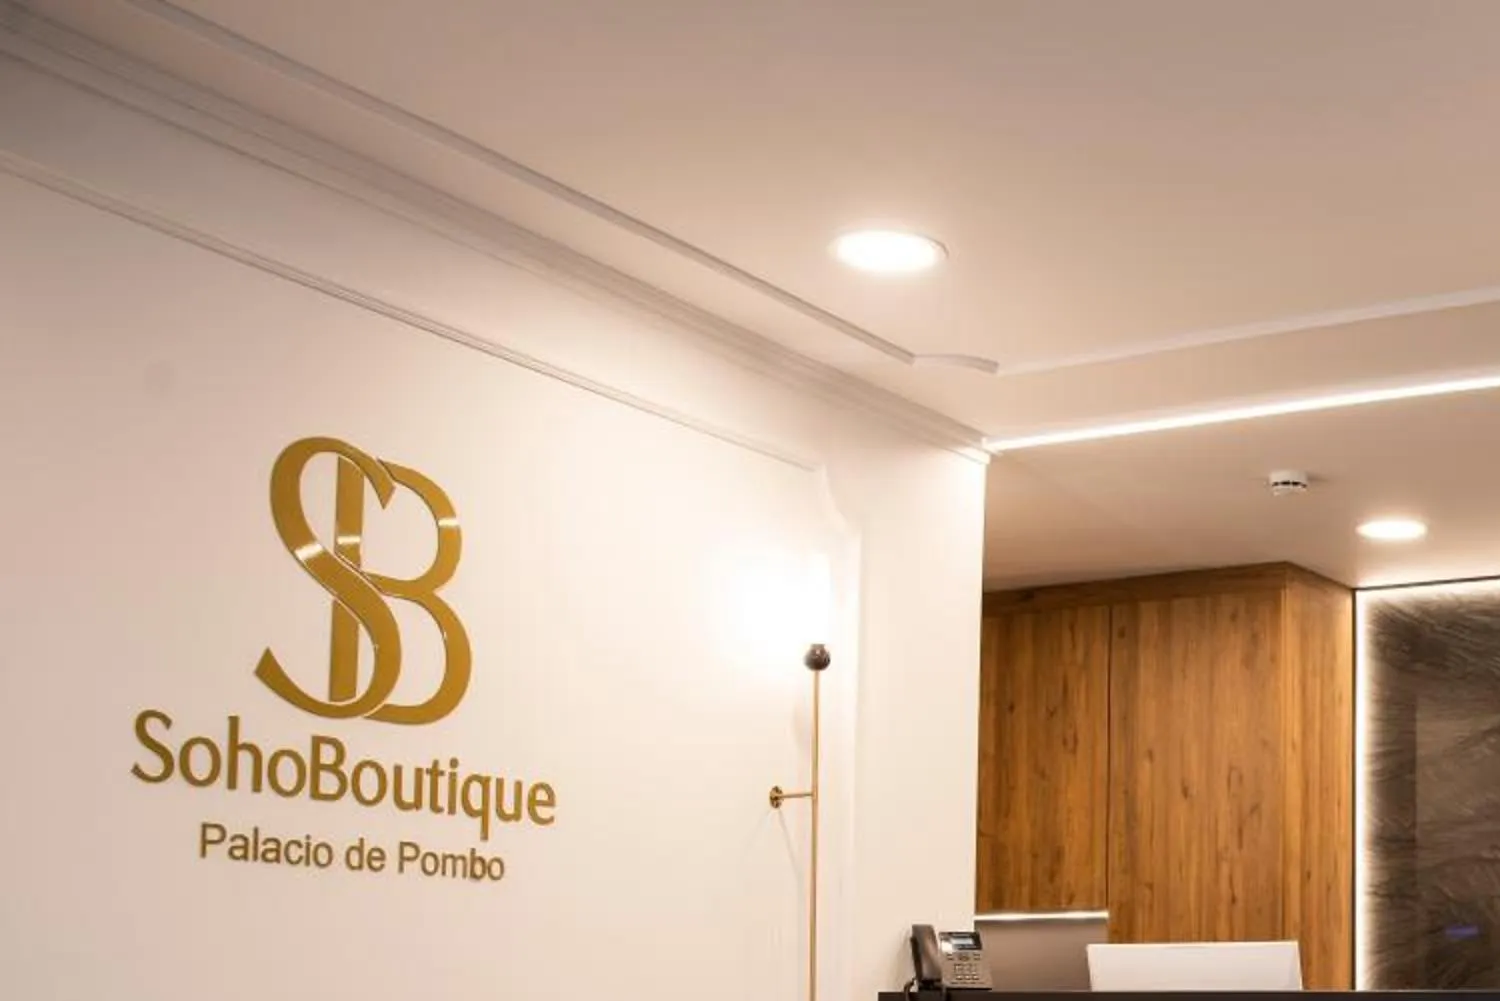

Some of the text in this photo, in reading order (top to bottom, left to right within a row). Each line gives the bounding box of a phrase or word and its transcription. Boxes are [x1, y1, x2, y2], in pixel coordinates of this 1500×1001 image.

[131, 709, 557, 841] SohoBoutique
[200, 822, 505, 881] Palacio de Pombo
